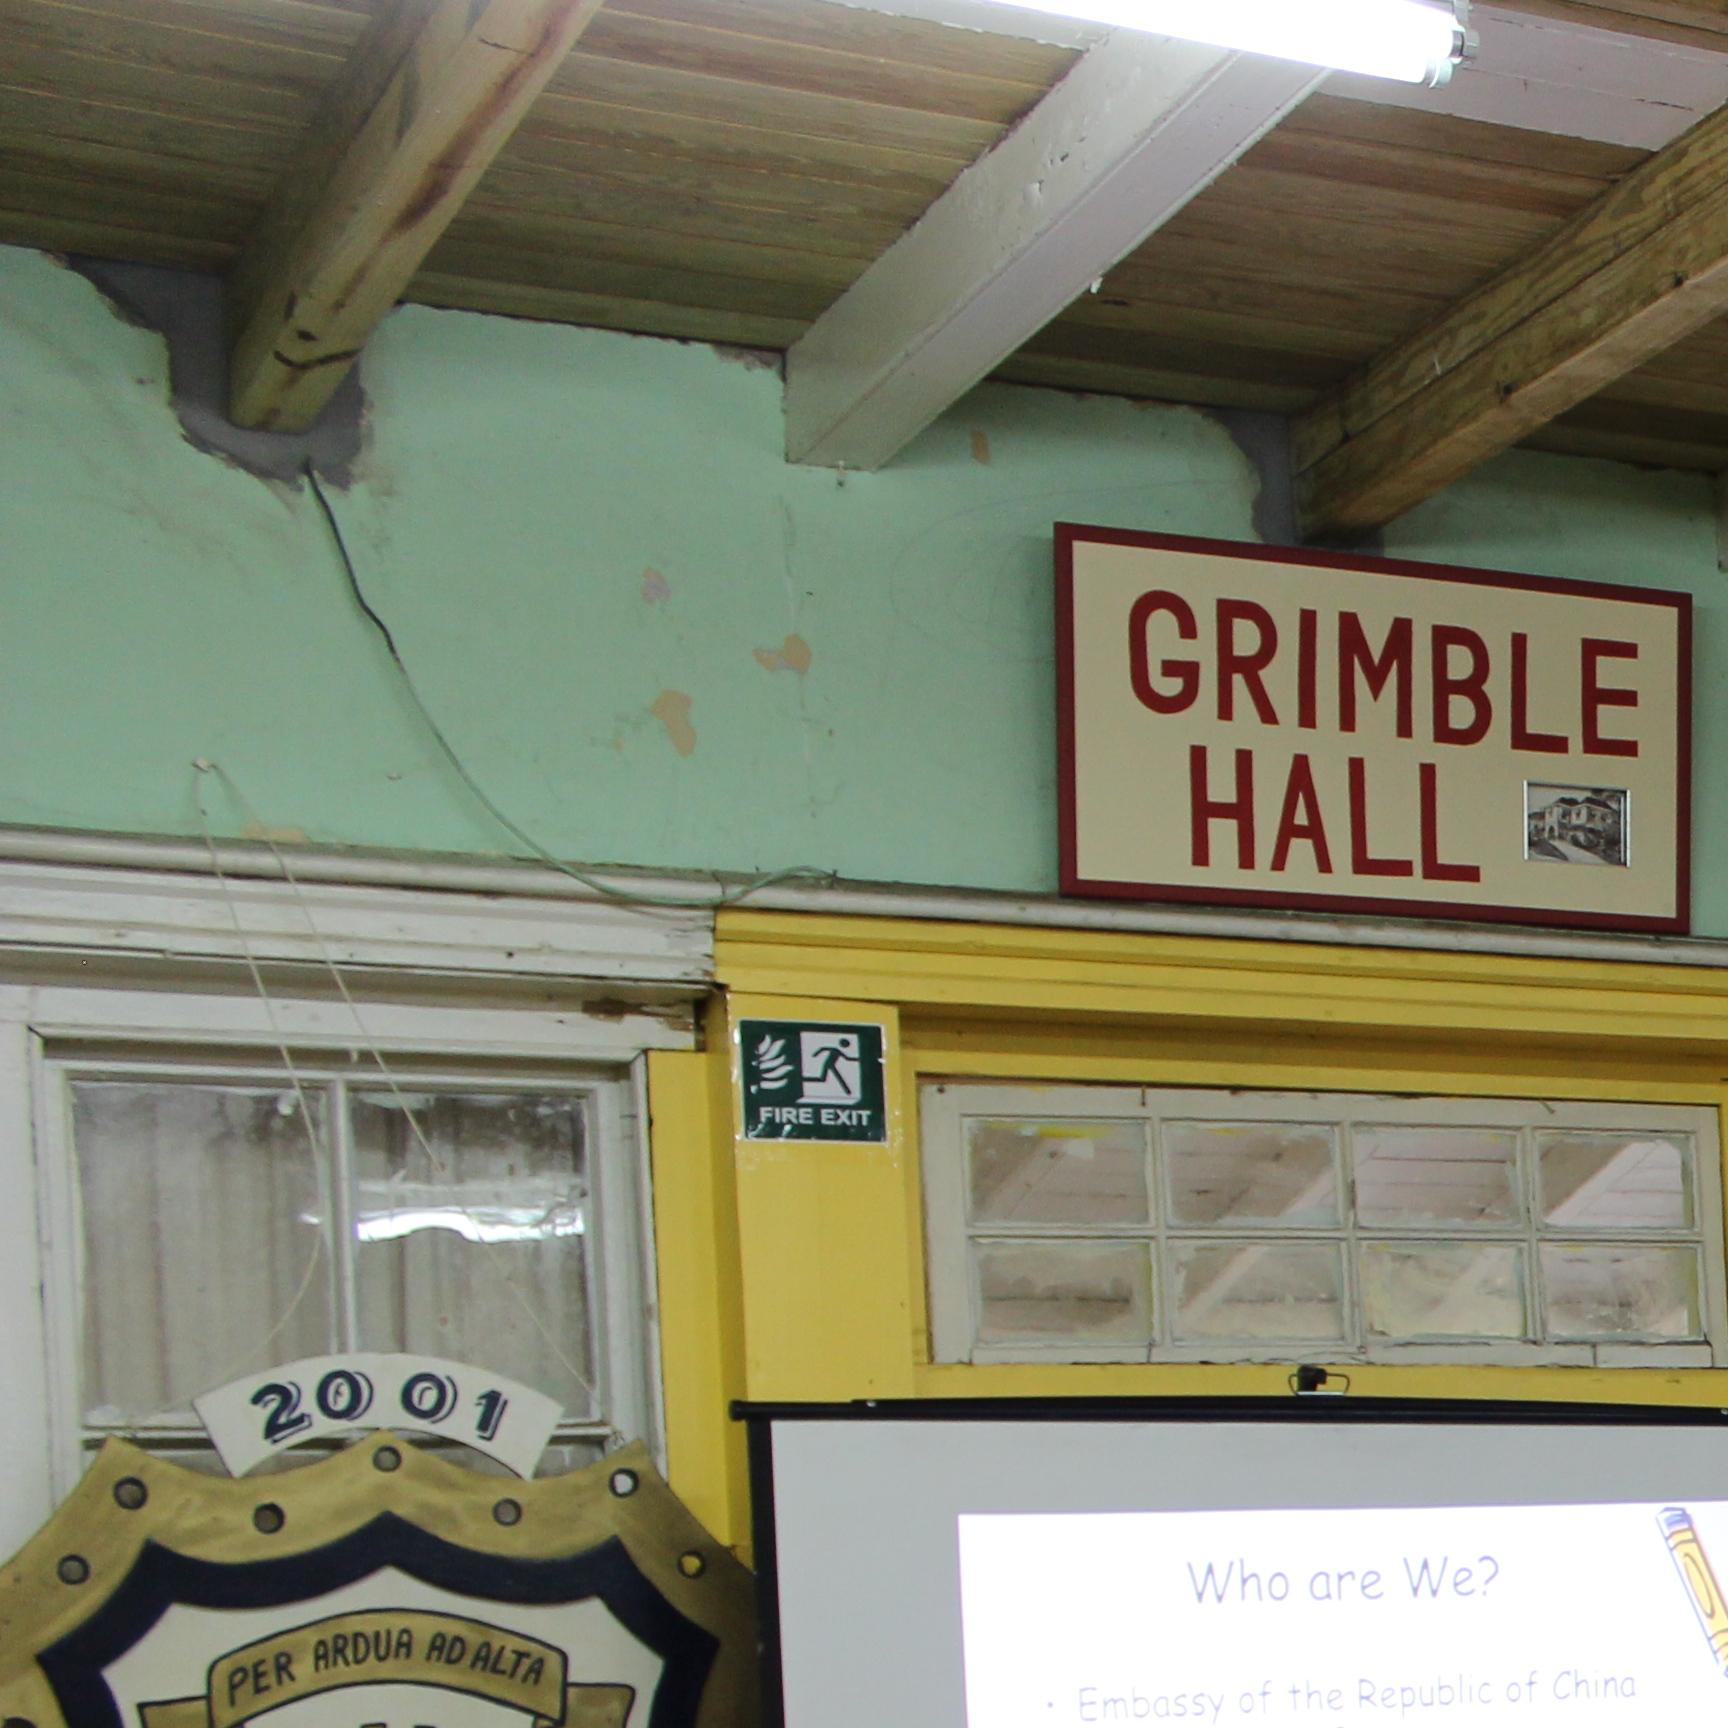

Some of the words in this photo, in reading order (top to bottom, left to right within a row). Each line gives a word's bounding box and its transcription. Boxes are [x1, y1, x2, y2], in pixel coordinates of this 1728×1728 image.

[1128, 589, 1638, 757] GRIMBLE
[1190, 745, 1480, 883] HALL
[759, 1106, 814, 1125] FIRE
[820, 1108, 872, 1127] EXIT
[251, 1369, 508, 1444] 2001
[1186, 1556, 1291, 1605] Who
[1308, 1566, 1385, 1601] are
[1403, 1554, 1501, 1599] We?
[228, 1651, 296, 1708] PER
[314, 1628, 413, 1673] ARDUA
[425, 1631, 467, 1667] AD
[470, 1641, 545, 1687] ALTA
[1078, 1685, 1224, 1724] Embassy
[1238, 1680, 1273, 1714] of
[1288, 1678, 1345, 1711] the
[1358, 1674, 1492, 1720] Republic
[1506, 1670, 1539, 1703] of
[1552, 1668, 1637, 1701] China
